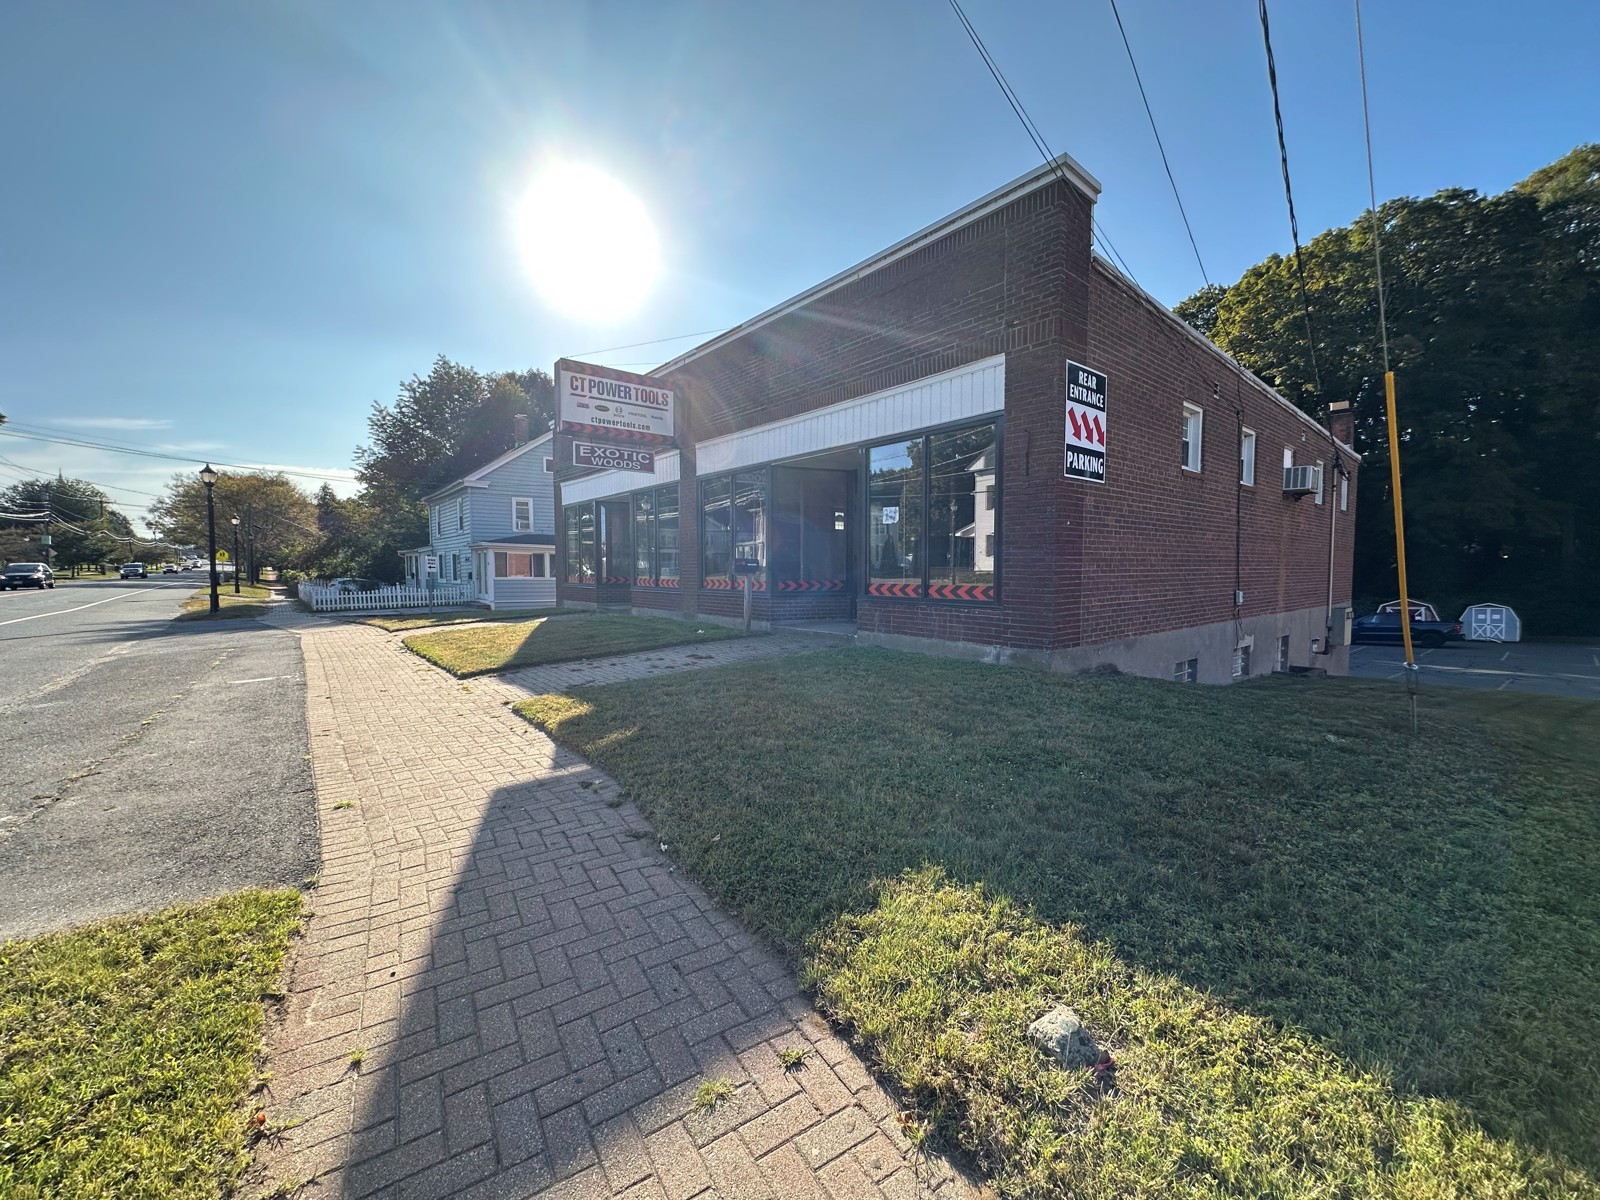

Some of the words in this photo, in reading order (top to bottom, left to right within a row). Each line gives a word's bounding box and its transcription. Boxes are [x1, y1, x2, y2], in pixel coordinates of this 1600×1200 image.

[1078, 370, 1097, 390] REAR
[570, 375, 587, 393] CT
[588, 378, 632, 401] POWER
[633, 387, 669, 407] TOOLS
[1069, 383, 1104, 408] ENTRANCE
[590, 416, 651, 431] ctpowertools.com
[580, 446, 650, 464] EXOTIC
[591, 457, 641, 469] WOODS
[1067, 451, 1104, 474] PARKING
